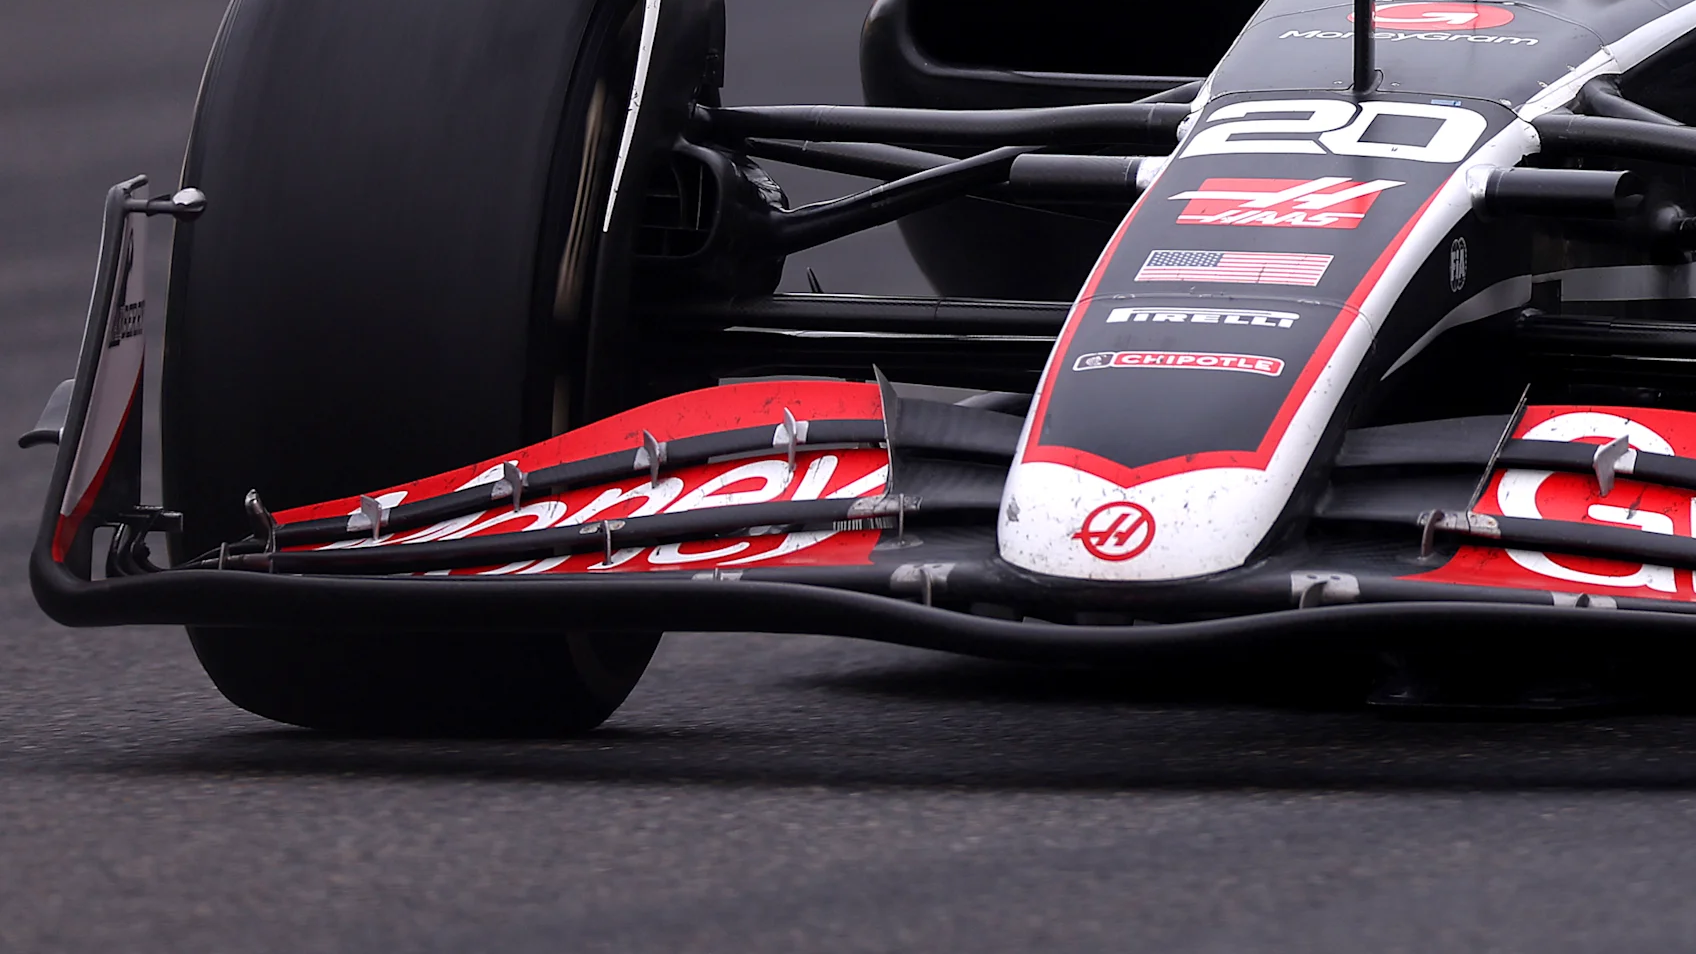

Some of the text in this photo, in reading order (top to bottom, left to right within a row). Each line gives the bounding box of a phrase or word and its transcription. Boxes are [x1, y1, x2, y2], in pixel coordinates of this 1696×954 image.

[1180, 99, 1489, 163] 20
[1178, 209, 1365, 227] HAAS
[1106, 307, 1300, 329] PIRELLI
[1120, 354, 1274, 372] CHIPOTLE
